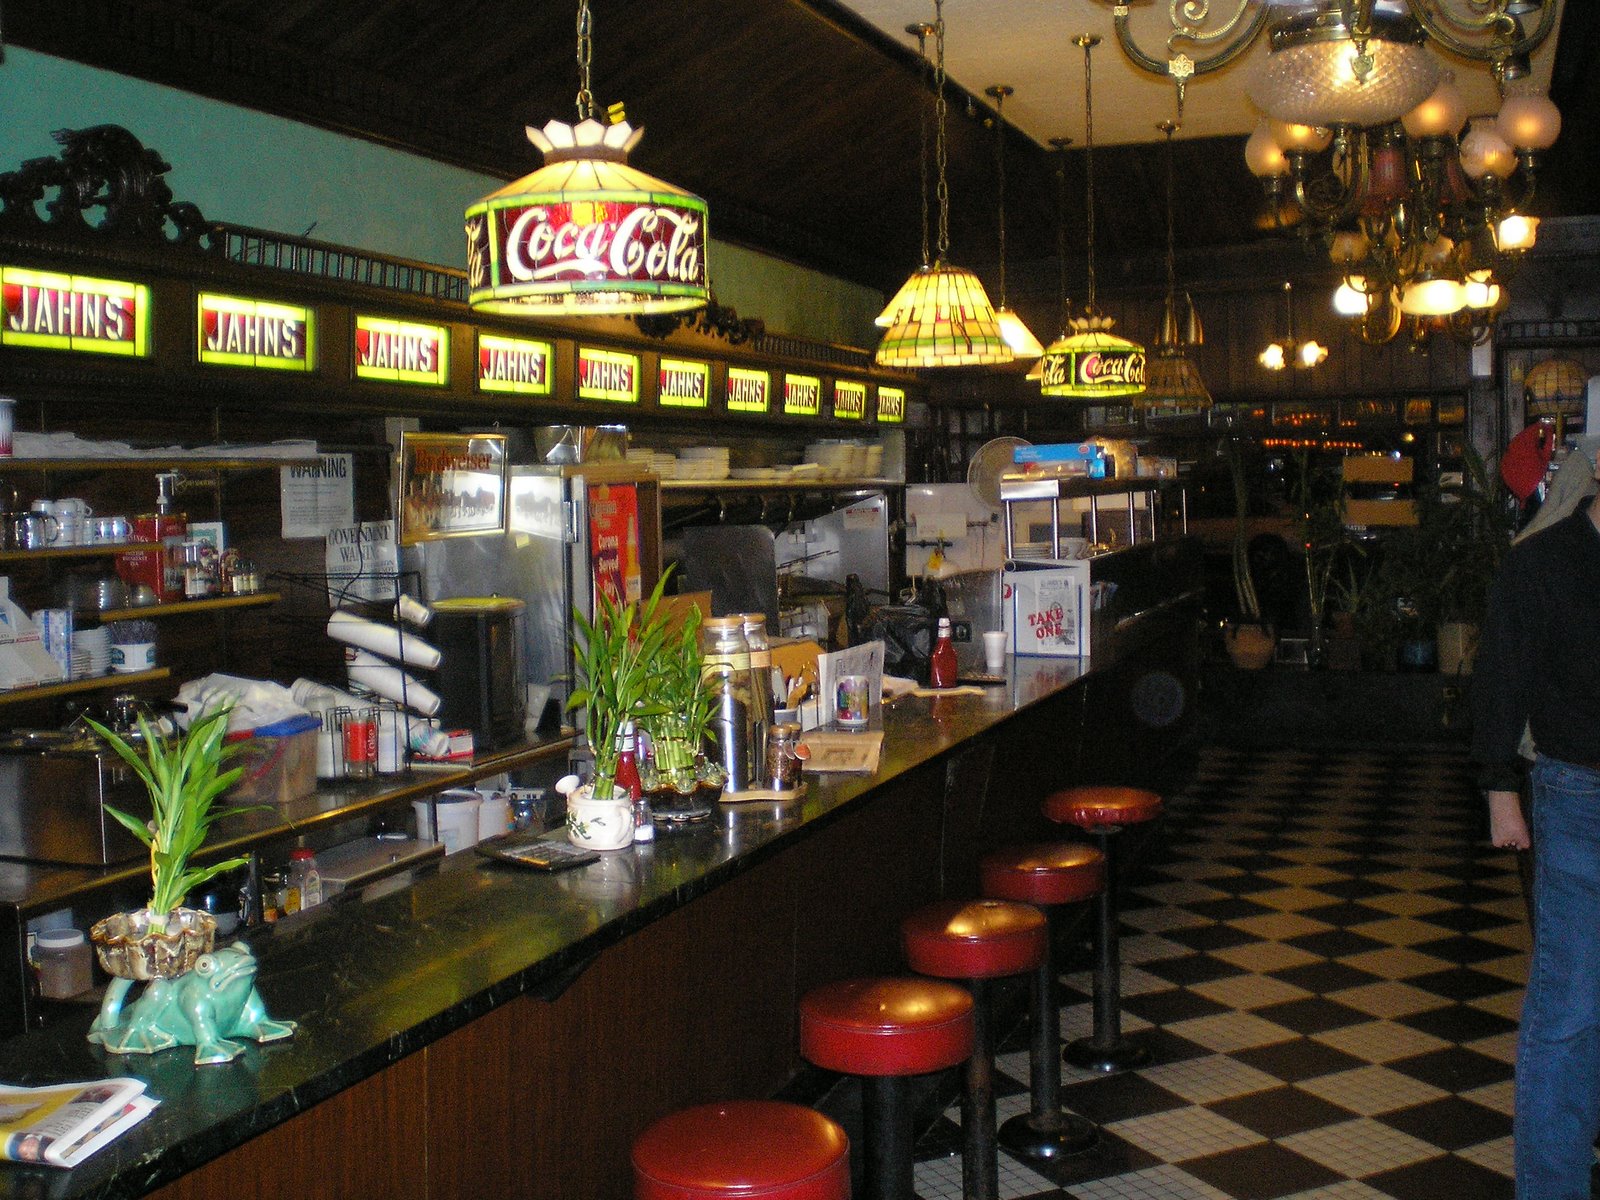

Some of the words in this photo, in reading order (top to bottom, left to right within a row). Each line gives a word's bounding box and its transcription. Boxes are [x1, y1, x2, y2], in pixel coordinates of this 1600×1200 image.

[10, 286, 123, 340] JAHNS
[207, 311, 299, 358] JAHNS
[362, 331, 433, 372] JAHNS
[484, 349, 542, 384] JAHNS
[582, 359, 629, 391] JAHNS
[661, 371, 702, 398] JAHNS
[728, 377, 763, 404] JAHNS
[785, 383, 816, 407] JAHNS
[1028, 607, 1064, 627] TAKE
[1035, 623, 1063, 640] ONE
